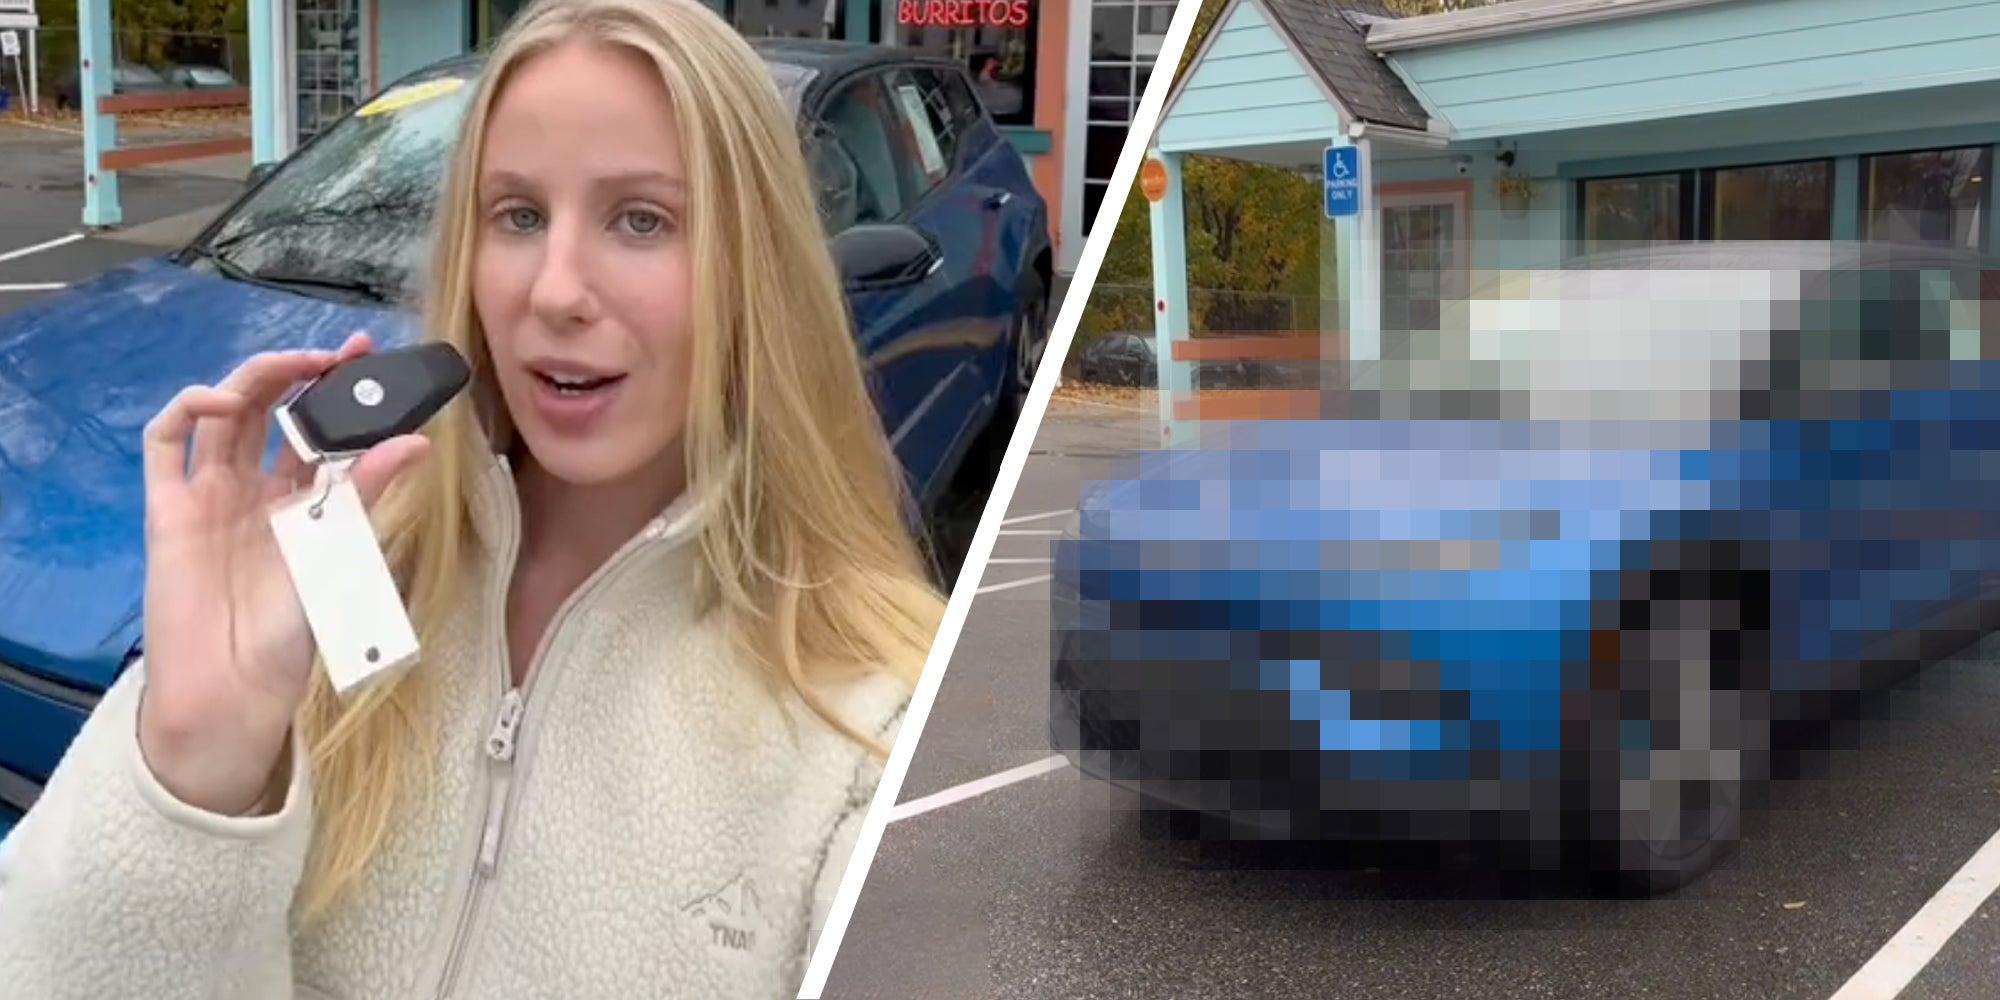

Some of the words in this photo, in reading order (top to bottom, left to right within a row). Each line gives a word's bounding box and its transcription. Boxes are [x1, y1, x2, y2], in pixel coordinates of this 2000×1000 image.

[898, 0, 1028, 24] BURRITOS
[1327, 179, 1359, 189] PARKING
[1331, 190, 1353, 200] ONLY
